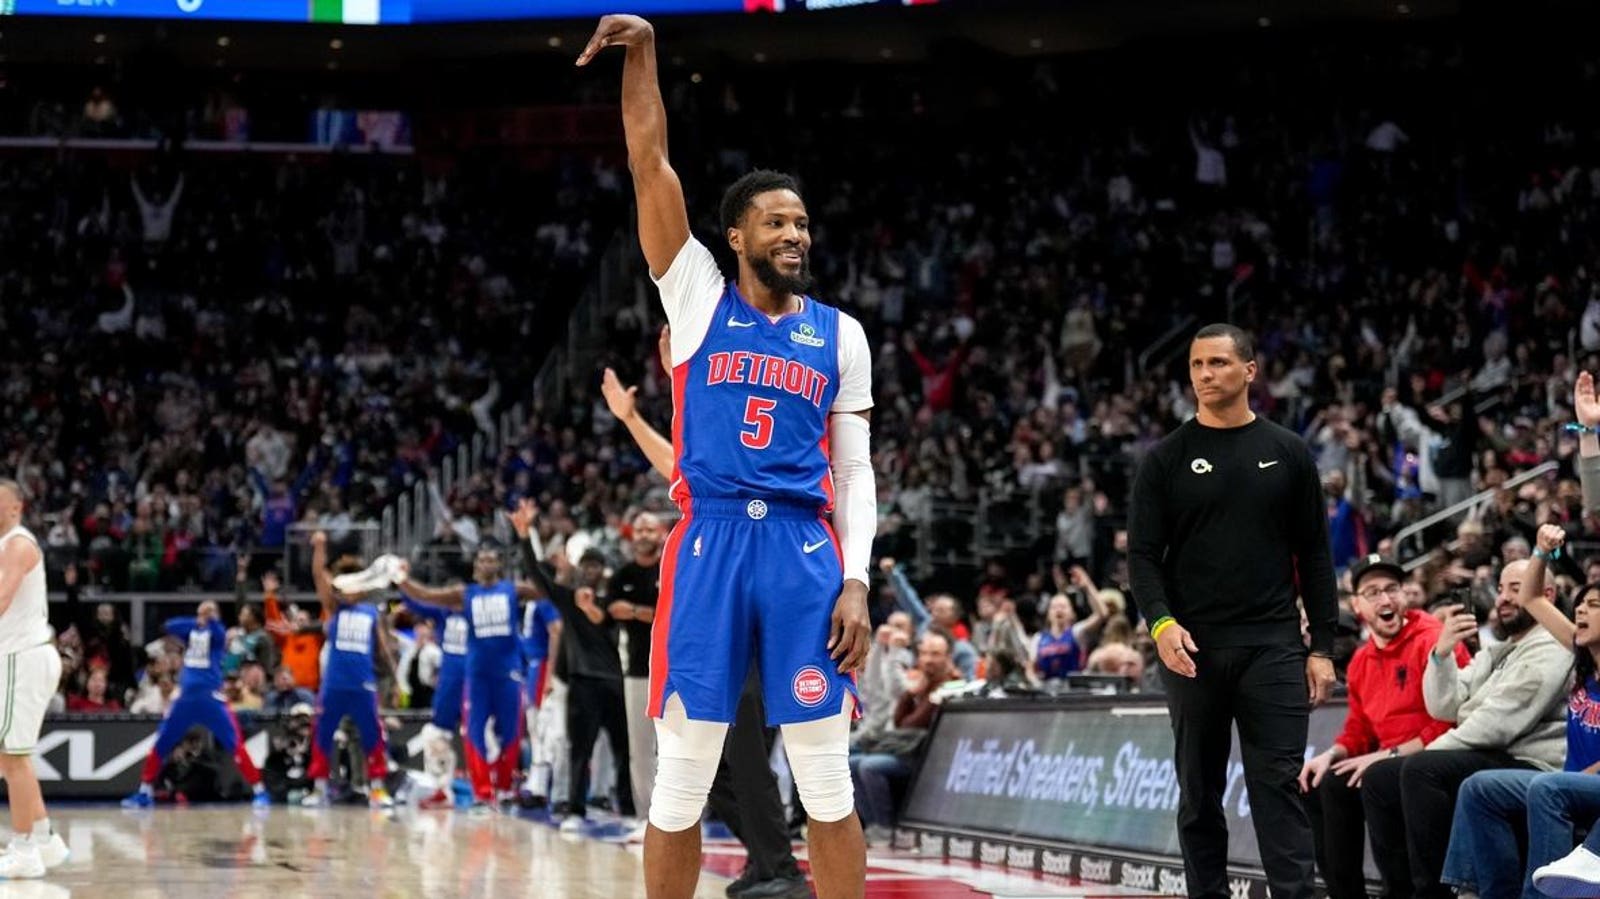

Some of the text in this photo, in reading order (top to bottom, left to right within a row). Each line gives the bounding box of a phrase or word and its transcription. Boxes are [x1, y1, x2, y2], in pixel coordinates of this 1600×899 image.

[707, 351, 829, 408] DETROIT
[740, 395, 777, 450] 5
[945, 738, 1020, 796] Verified
[1007, 739, 1104, 816] Sneakers,
[1121, 861, 1156, 889] StockX
[1159, 867, 1189, 897] Stock
